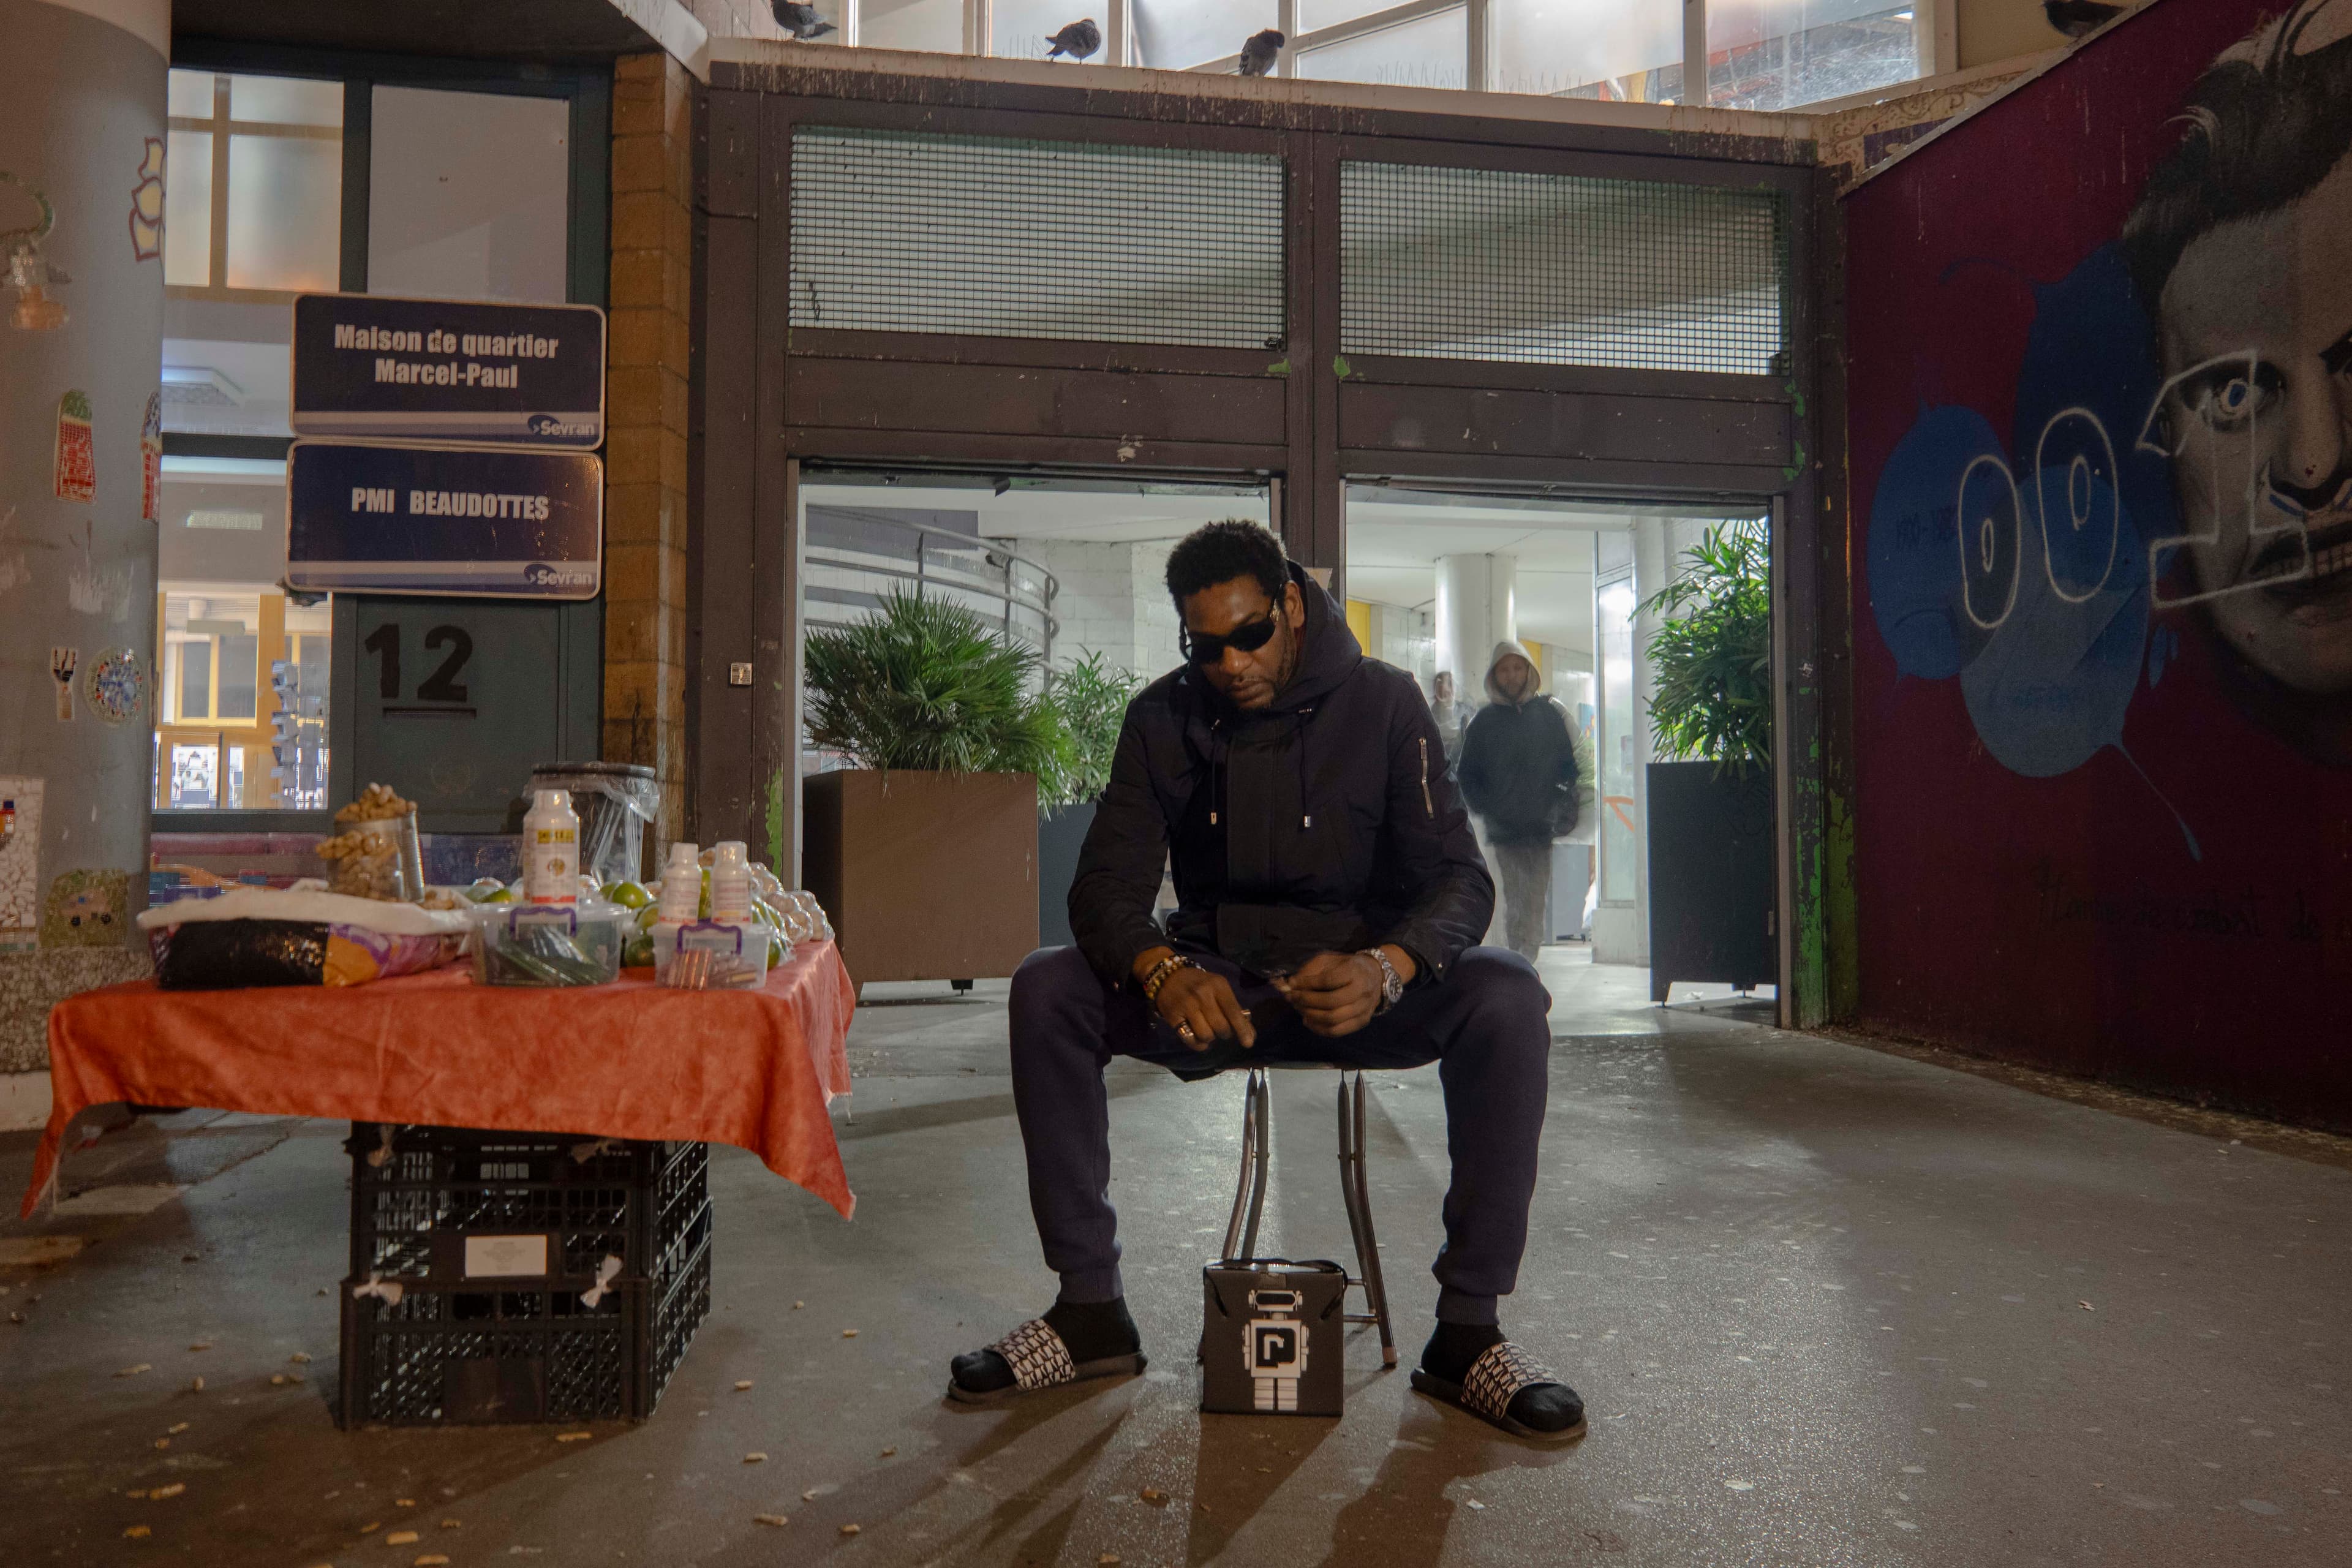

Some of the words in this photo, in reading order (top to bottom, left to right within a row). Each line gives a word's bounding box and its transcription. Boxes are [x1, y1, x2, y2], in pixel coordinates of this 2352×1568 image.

[335, 324, 421, 352] Maison
[428, 329, 457, 354] de
[462, 333, 559, 359] quartier
[375, 358, 518, 389] Marcel-Paul
[540, 420, 594, 436] Sevran
[352, 487, 395, 513] PMI
[410, 490, 550, 521] BEAUDOTTES
[537, 569, 592, 586] Sevran
[365, 624, 473, 702] 12
